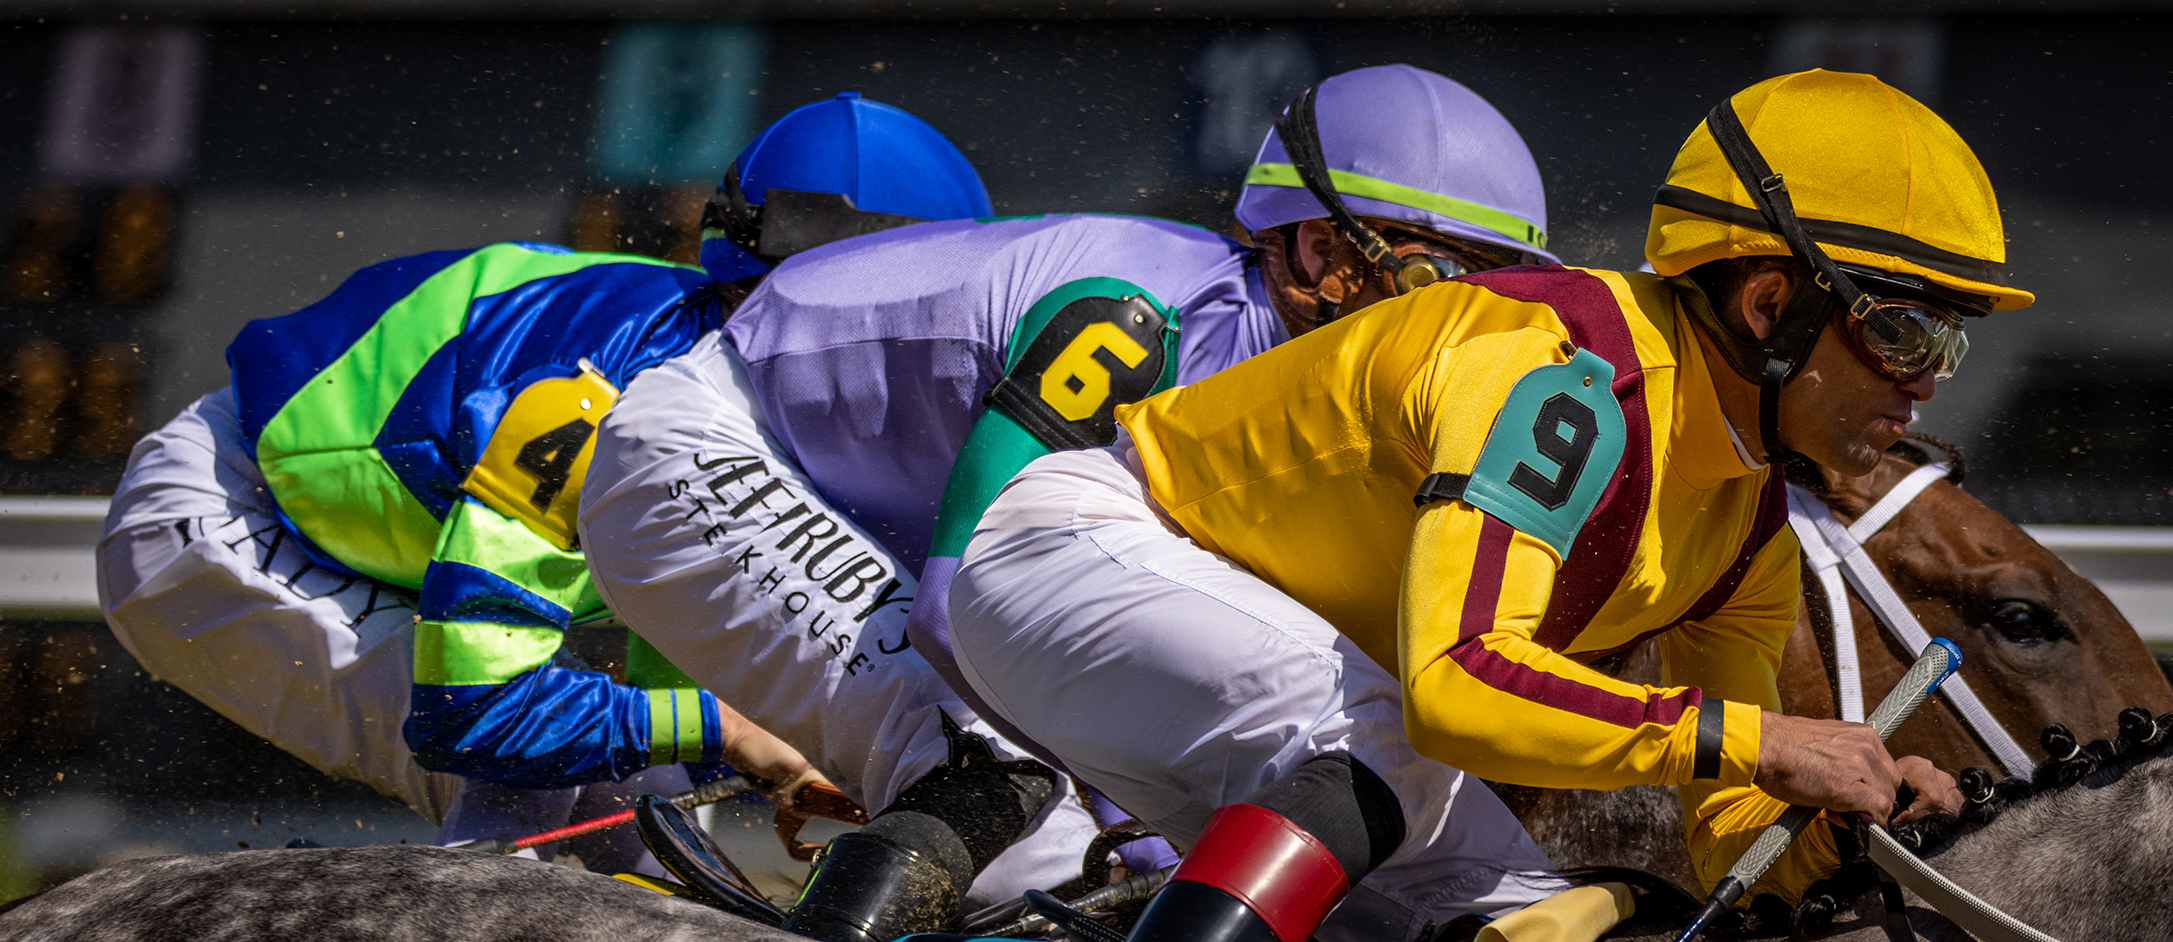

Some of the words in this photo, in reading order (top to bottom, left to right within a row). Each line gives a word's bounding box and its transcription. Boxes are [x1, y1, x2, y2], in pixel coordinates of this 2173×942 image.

[1039, 321, 1149, 422] 6
[513, 417, 597, 517] 4
[1507, 391, 1599, 513] 9
[668, 478, 869, 677] STEKHOUSE
